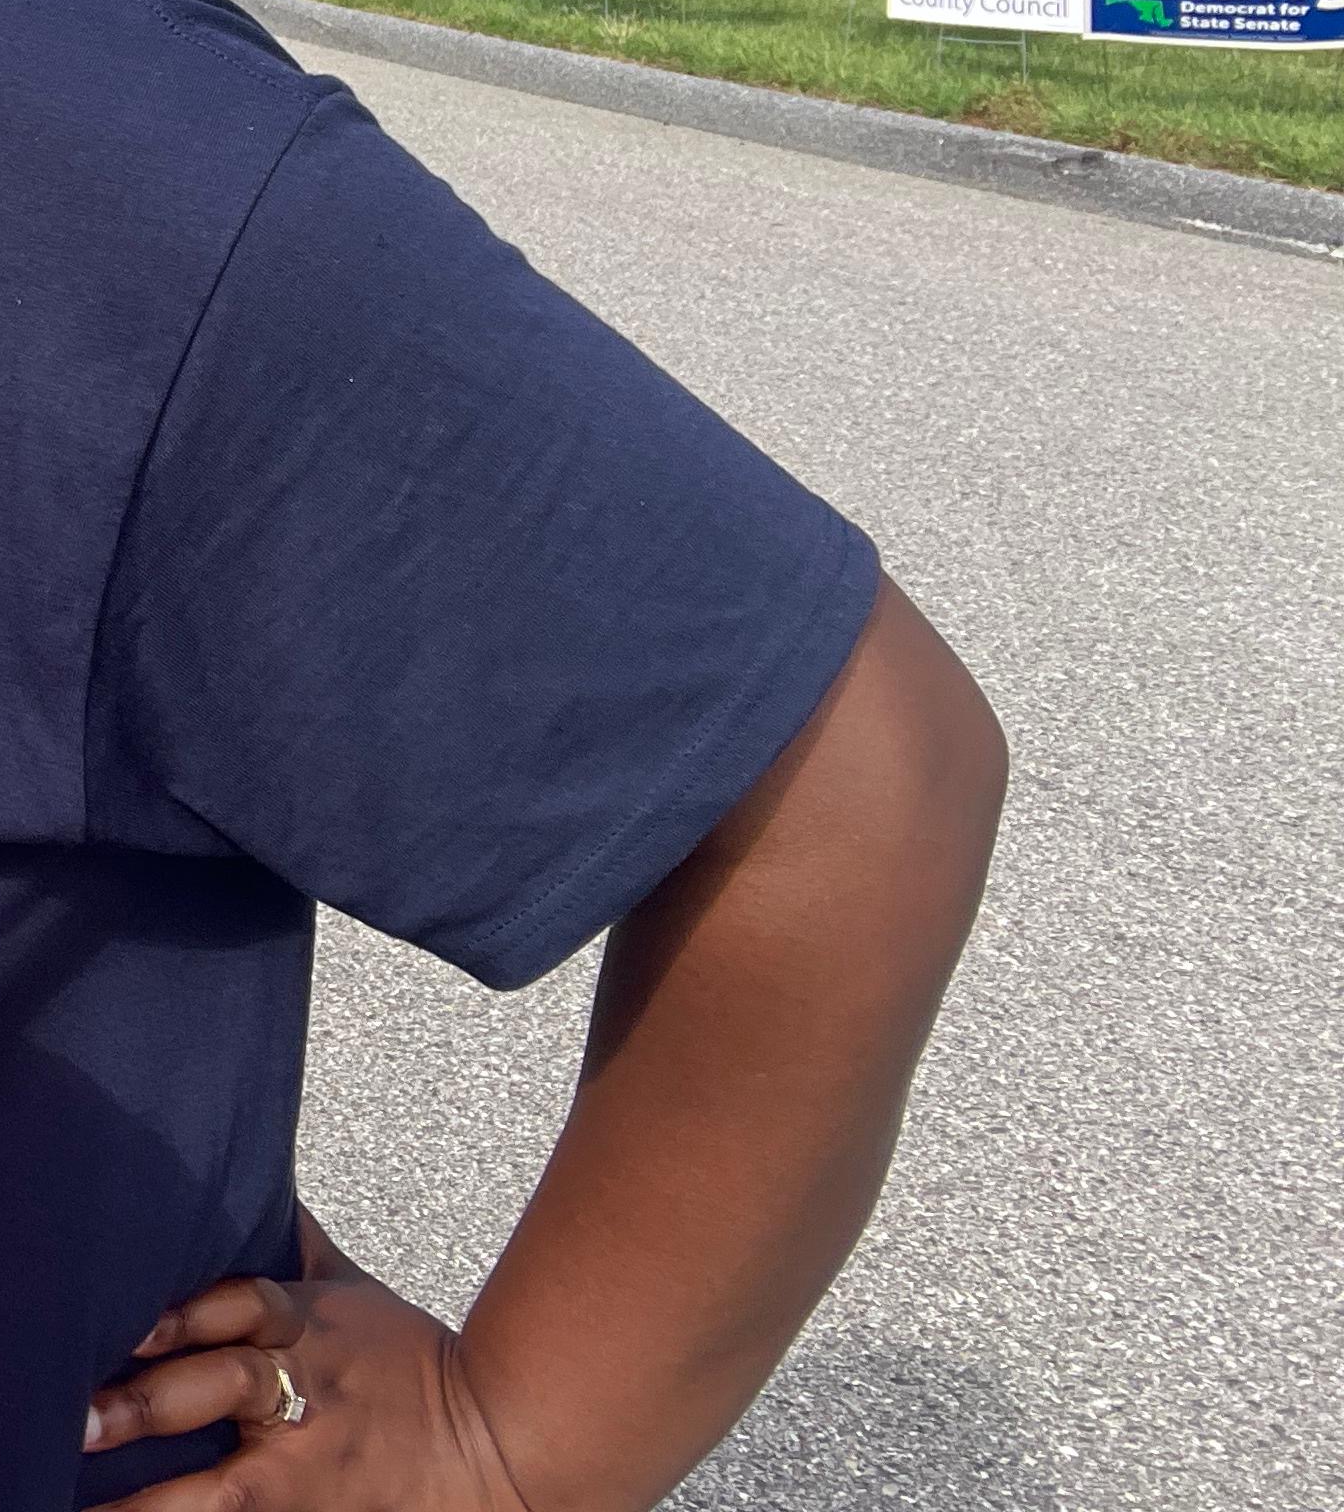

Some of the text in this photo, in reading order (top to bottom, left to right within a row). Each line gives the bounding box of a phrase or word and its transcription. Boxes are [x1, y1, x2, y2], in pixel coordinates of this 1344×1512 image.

[1180, 0, 1310, 16] Democrat for
[1180, 16, 1301, 32] State Senate
